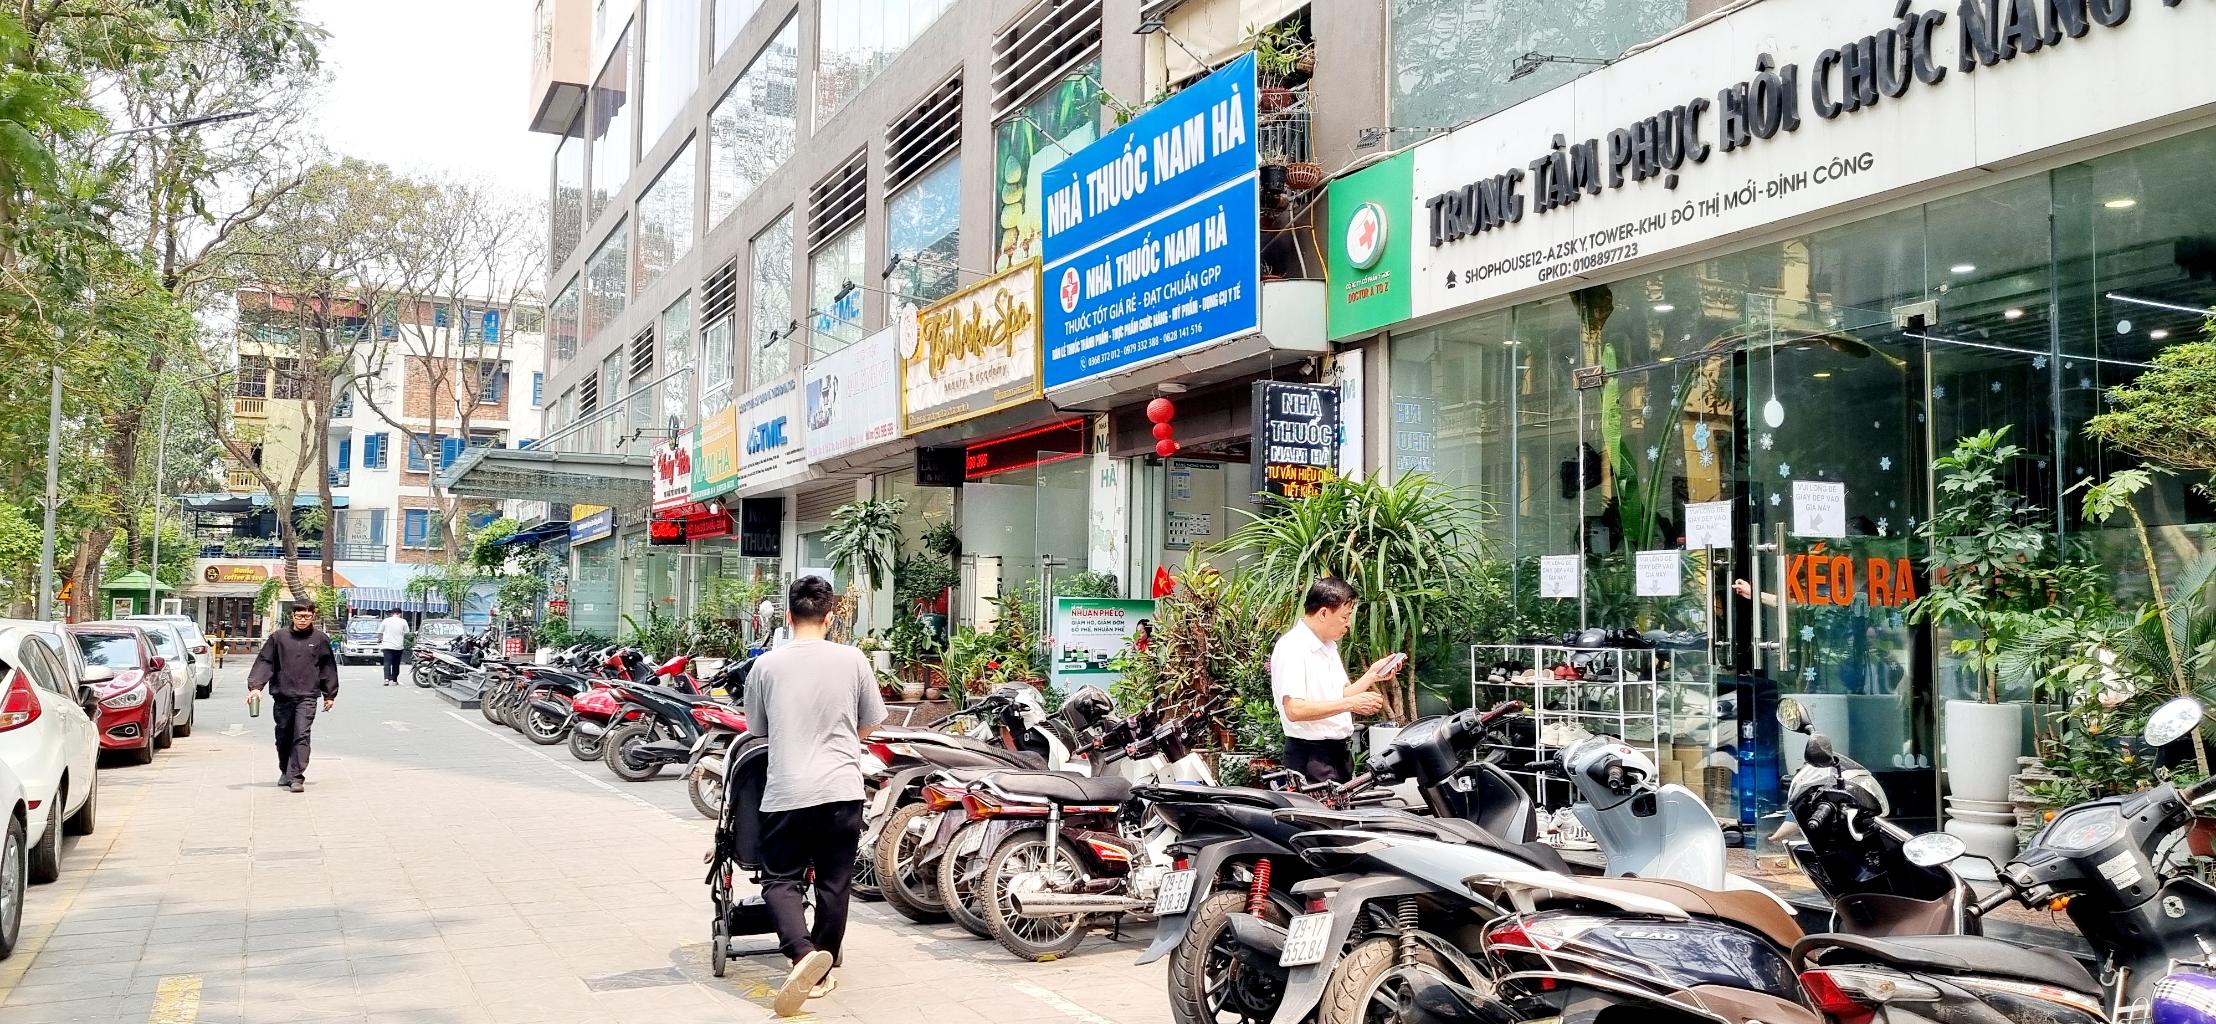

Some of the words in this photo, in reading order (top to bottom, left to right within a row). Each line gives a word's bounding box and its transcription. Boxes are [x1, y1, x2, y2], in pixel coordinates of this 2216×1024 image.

[1425, 167, 1525, 247] TRUNG
[1528, 133, 1602, 214] TÂM
[1607, 97, 1710, 190] PHỤC
[1812, 0, 1947, 119] CHỨC
[1047, 172, 1082, 238] NHÀ
[1086, 132, 1147, 217] THUỐC
[1153, 112, 1205, 186] NAM
[1212, 82, 1246, 157] HÀ
[1671, 200, 1695, 225] ĐÔ
[1698, 193, 1719, 217] THỊ
[1812, 152, 1874, 185] CÔNG
[1085, 255, 1112, 299] NHÀ
[1116, 231, 1160, 288] THUỐC
[1164, 222, 1200, 268] NAM
[1205, 205, 1227, 252] HÀ
[1065, 310, 1091, 335] THUỐC
[1092, 303, 1107, 325] TỐT
[1109, 298, 1124, 319] GIÁ
[1126, 292, 1136, 314] RẺ
[1143, 287, 1162, 309] ĐẠT
[1164, 270, 1198, 299] CHUẨN
[1201, 265, 1221, 287] GPP
[1190, 323, 1203, 334] 516
[1281, 391, 1322, 416] NHÀ
[1270, 417, 1332, 445] THUỐC
[1271, 445, 1308, 463] NAM
[1311, 446, 1330, 465] HÀ
[1268, 465, 1279, 479] TƯ
[1280, 464, 1297, 479] VẤN
[1298, 466, 1316, 481] HIỆU
[1785, 541, 1855, 606] KÉO
[1868, 557, 1917, 607] RA
[1164, 872, 1190, 893] 29-E1
[1293, 918, 1327, 940] 29-Y7
[1614, 930, 1679, 941] LEAD
[1284, 939, 1322, 962] 552.84
